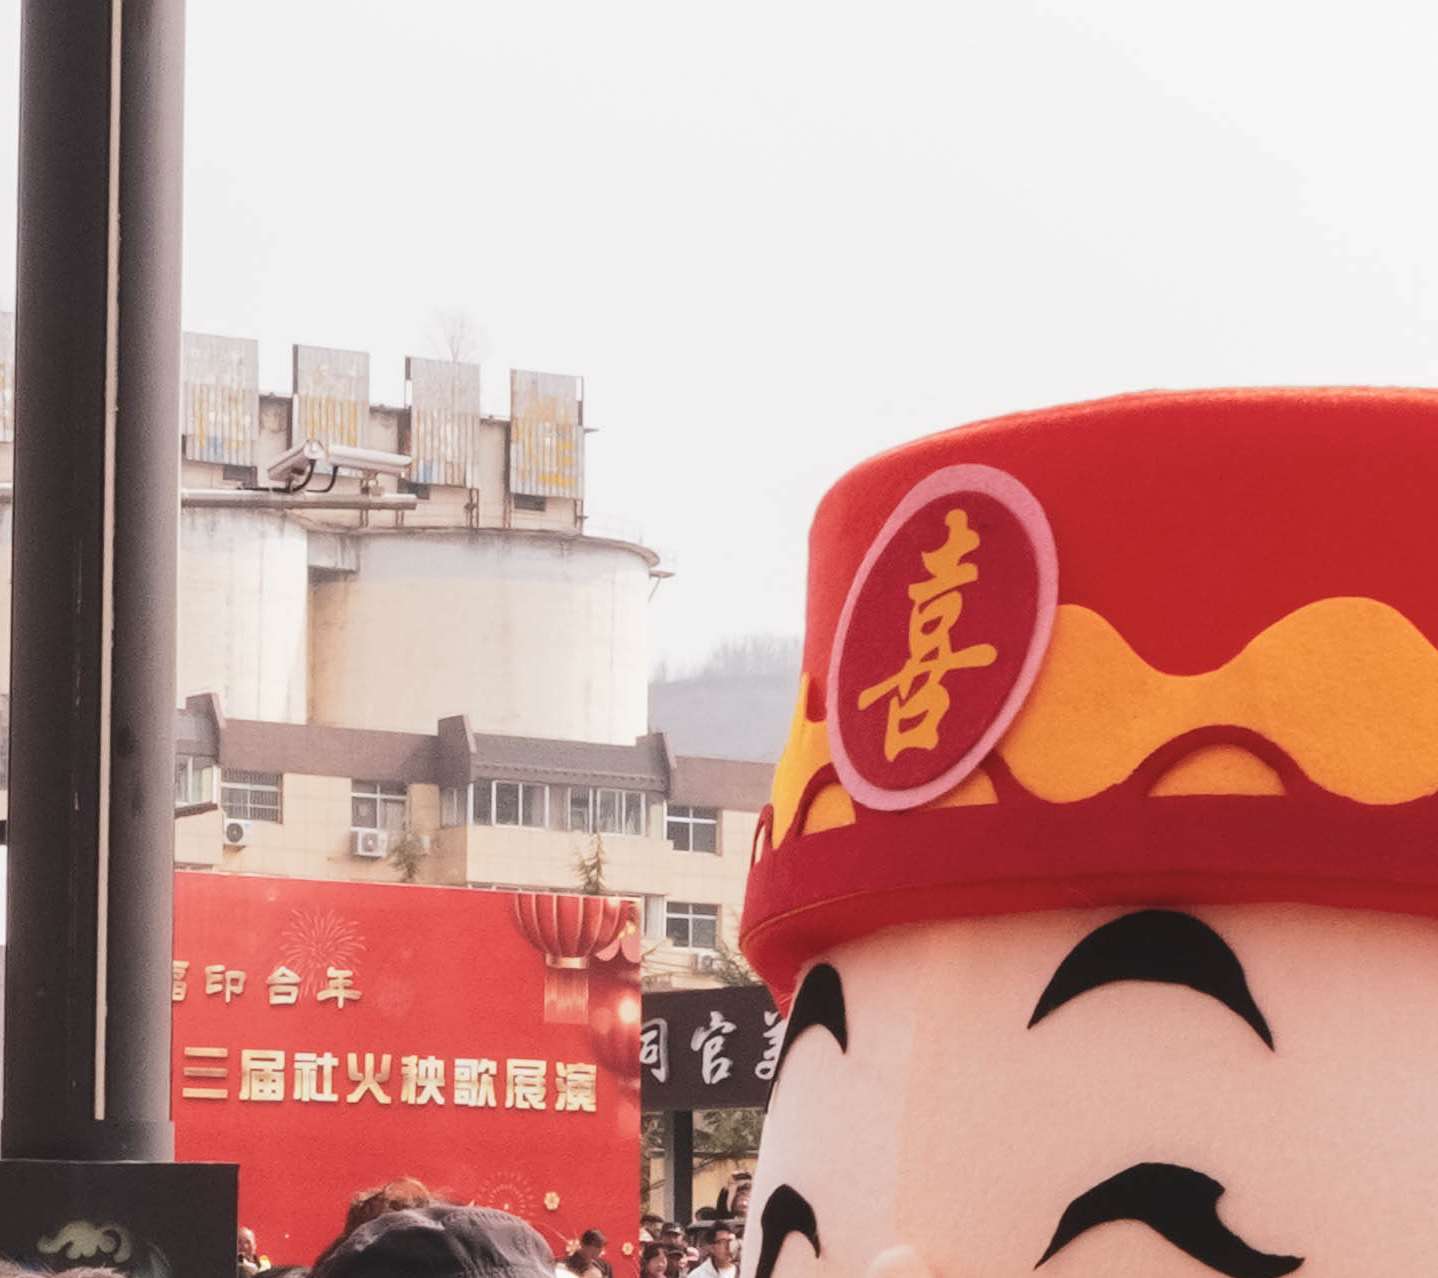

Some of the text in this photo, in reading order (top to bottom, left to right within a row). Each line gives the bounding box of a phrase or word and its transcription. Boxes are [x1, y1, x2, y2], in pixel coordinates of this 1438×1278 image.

[858, 508, 998, 763] 喜
[182, 1046, 598, 1113] 三届社火秧歌展演
